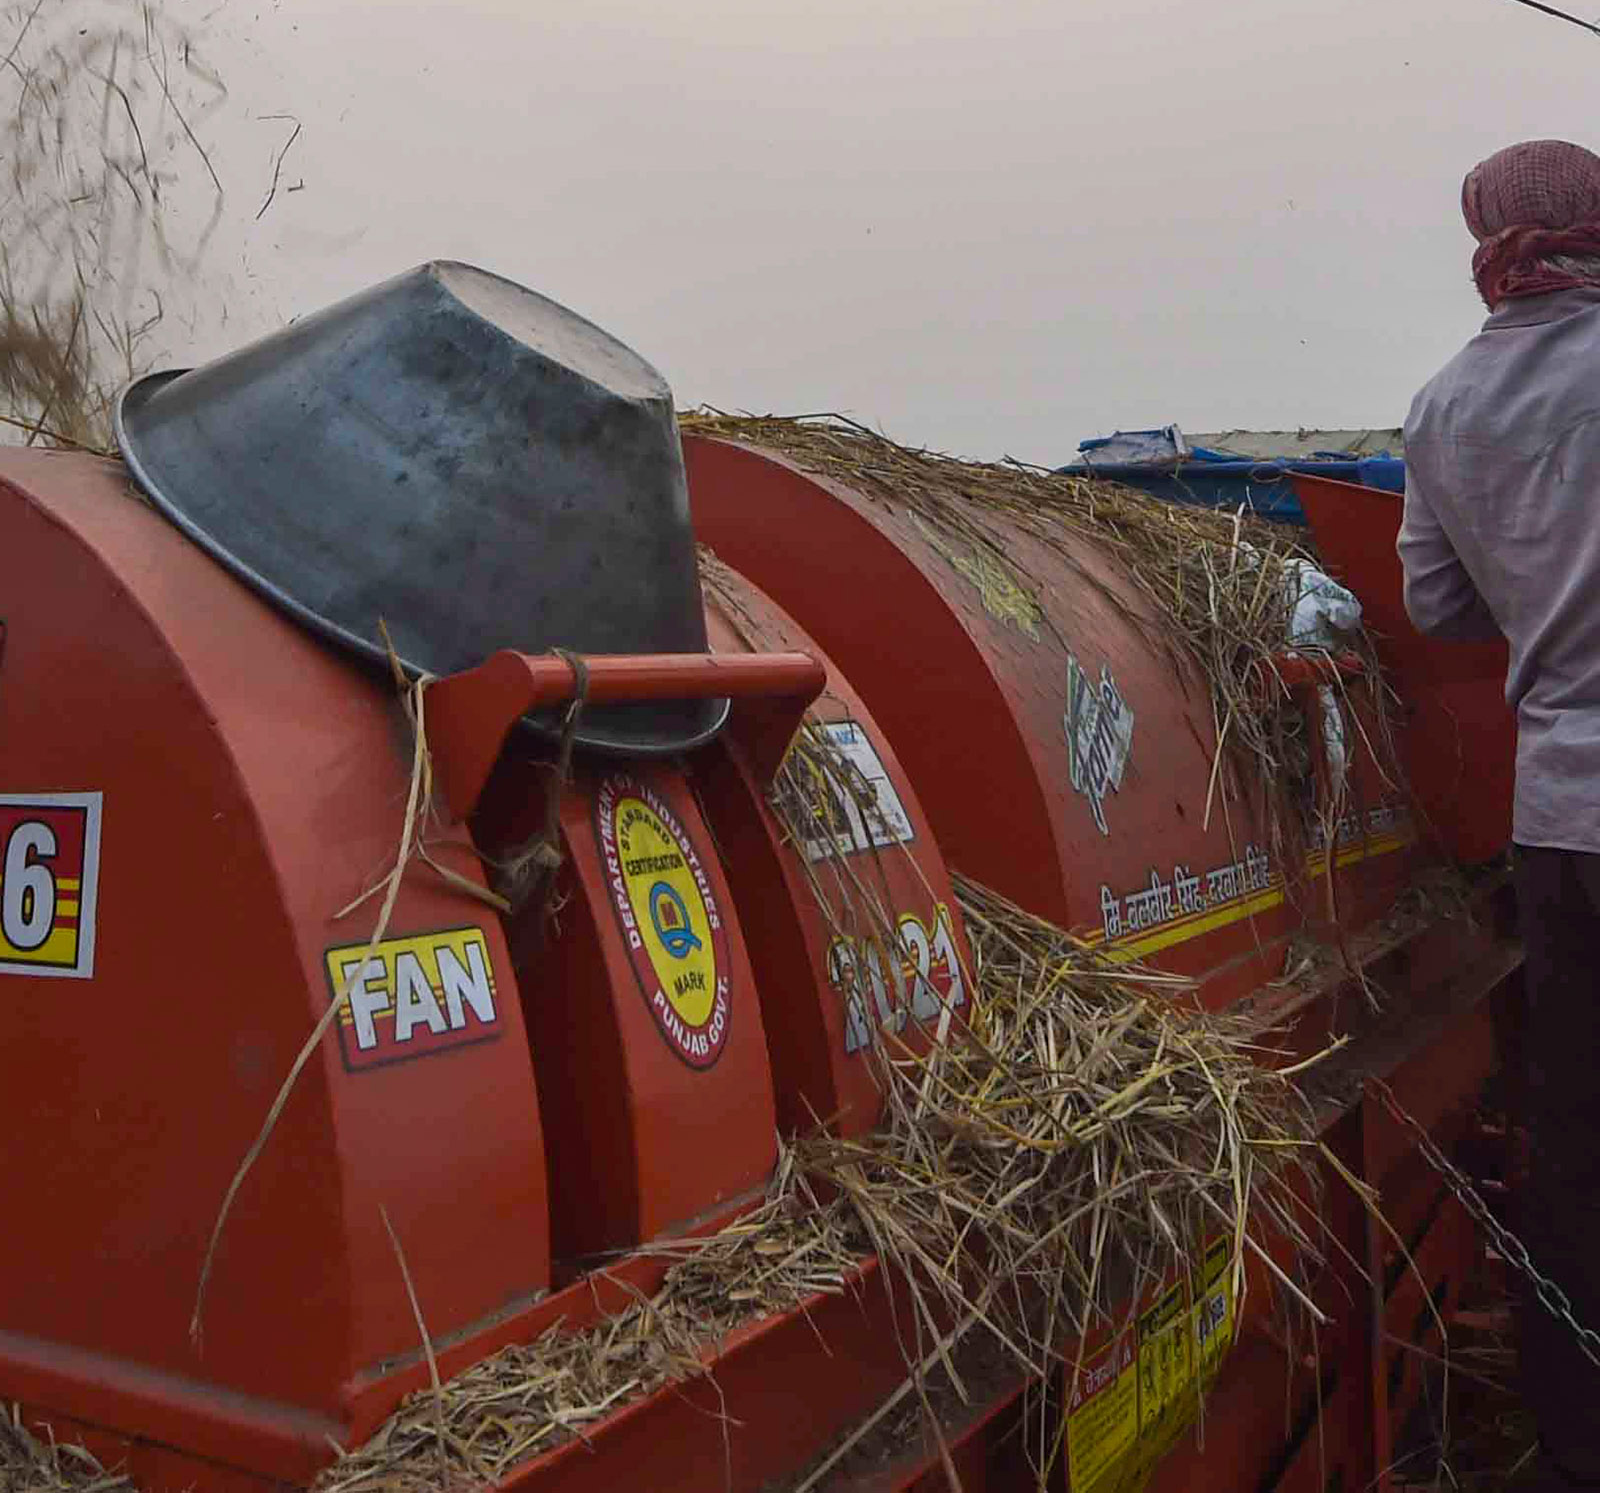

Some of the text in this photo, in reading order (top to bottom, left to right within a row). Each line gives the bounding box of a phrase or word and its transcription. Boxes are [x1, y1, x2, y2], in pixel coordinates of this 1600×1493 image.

[620, 808, 671, 852] STANDARD
[599, 778, 642, 949] DEPARTMENT
[639, 784, 720, 930] INDUSTRIES
[625, 852, 684, 877] CERTIFICATION
[342, 942, 497, 1050] FAN
[654, 975, 729, 1056] PUNJAB GOVT.
[673, 970, 706, 999] MARK
